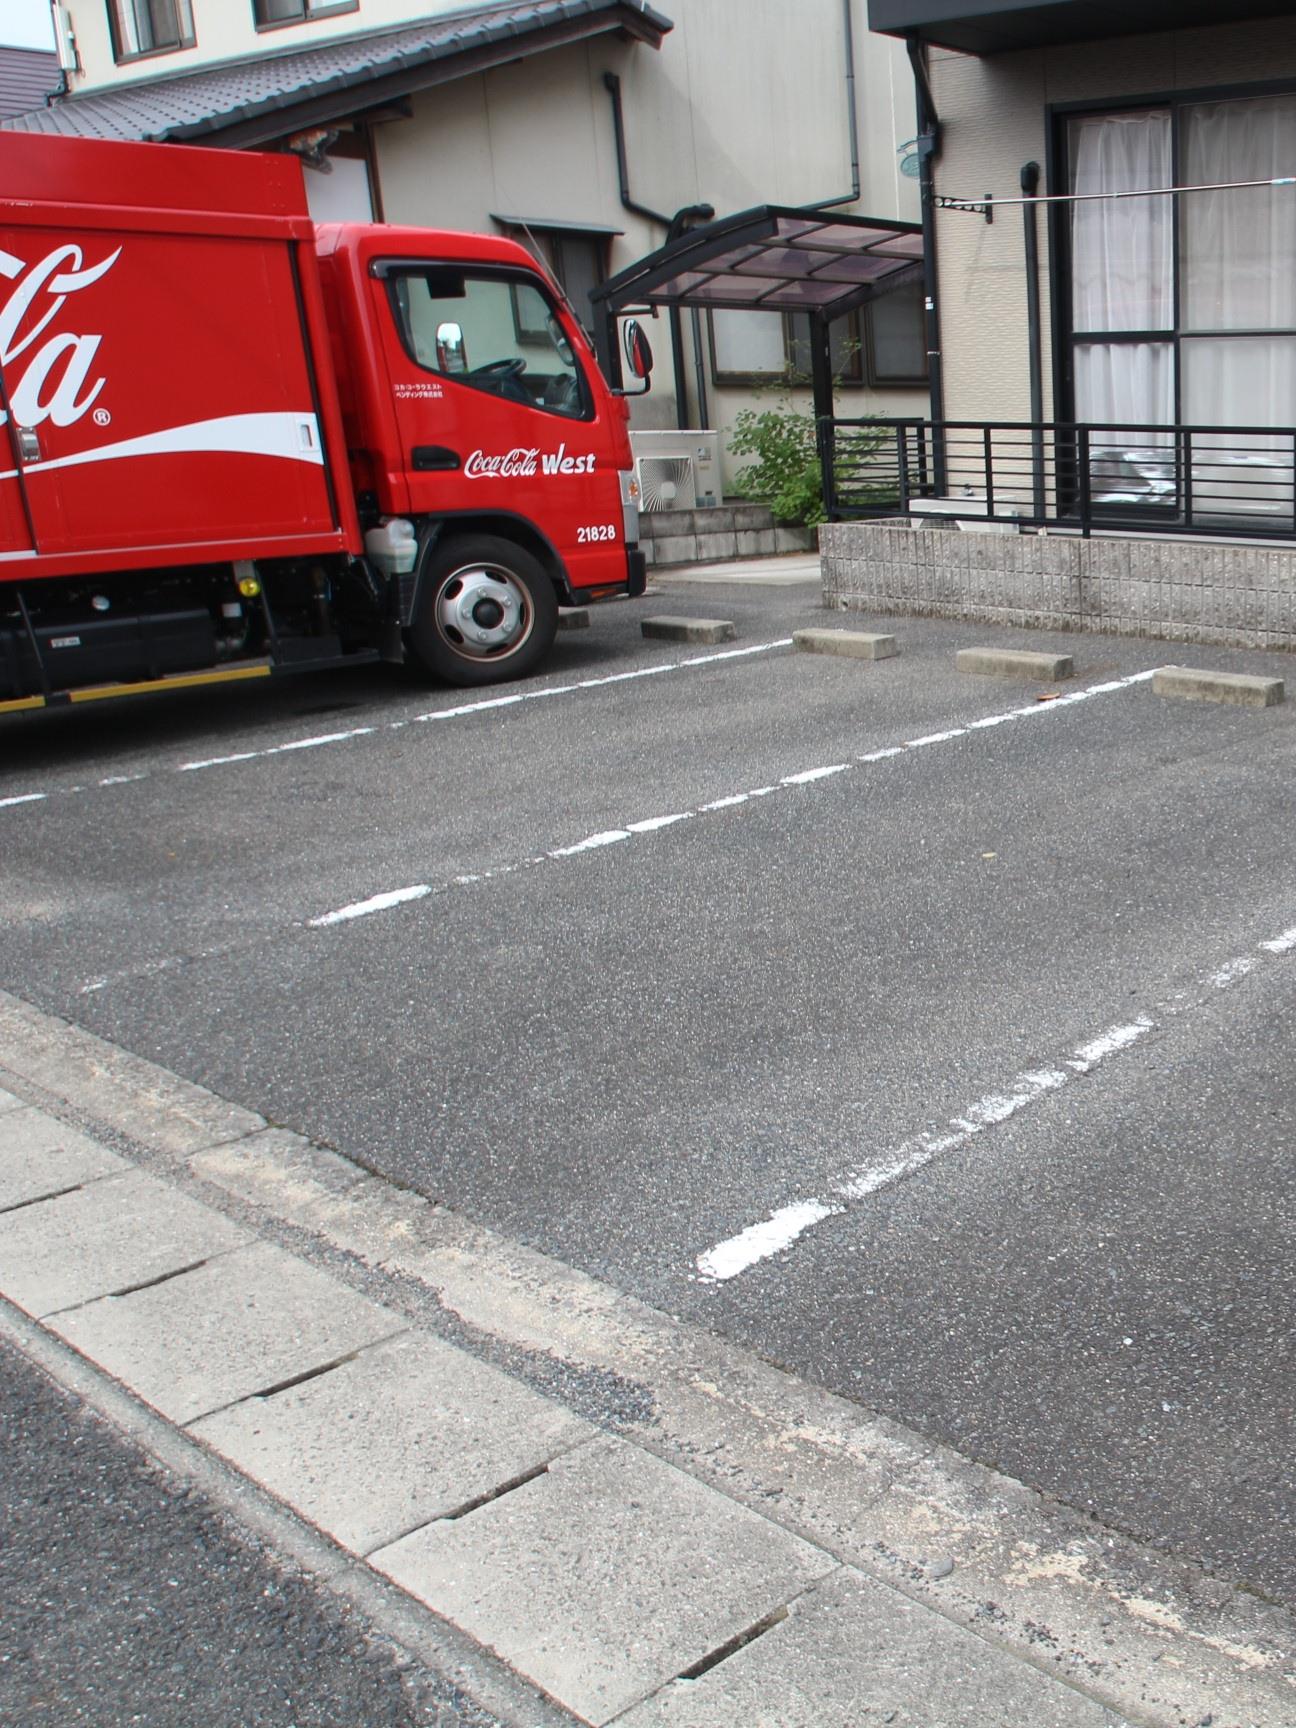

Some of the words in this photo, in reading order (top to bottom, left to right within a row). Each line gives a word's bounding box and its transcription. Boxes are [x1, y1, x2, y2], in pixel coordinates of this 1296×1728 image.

[464, 448, 540, 479] Coca-Cola
[541, 443, 595, 475] West
[576, 525, 616, 543] 21828
